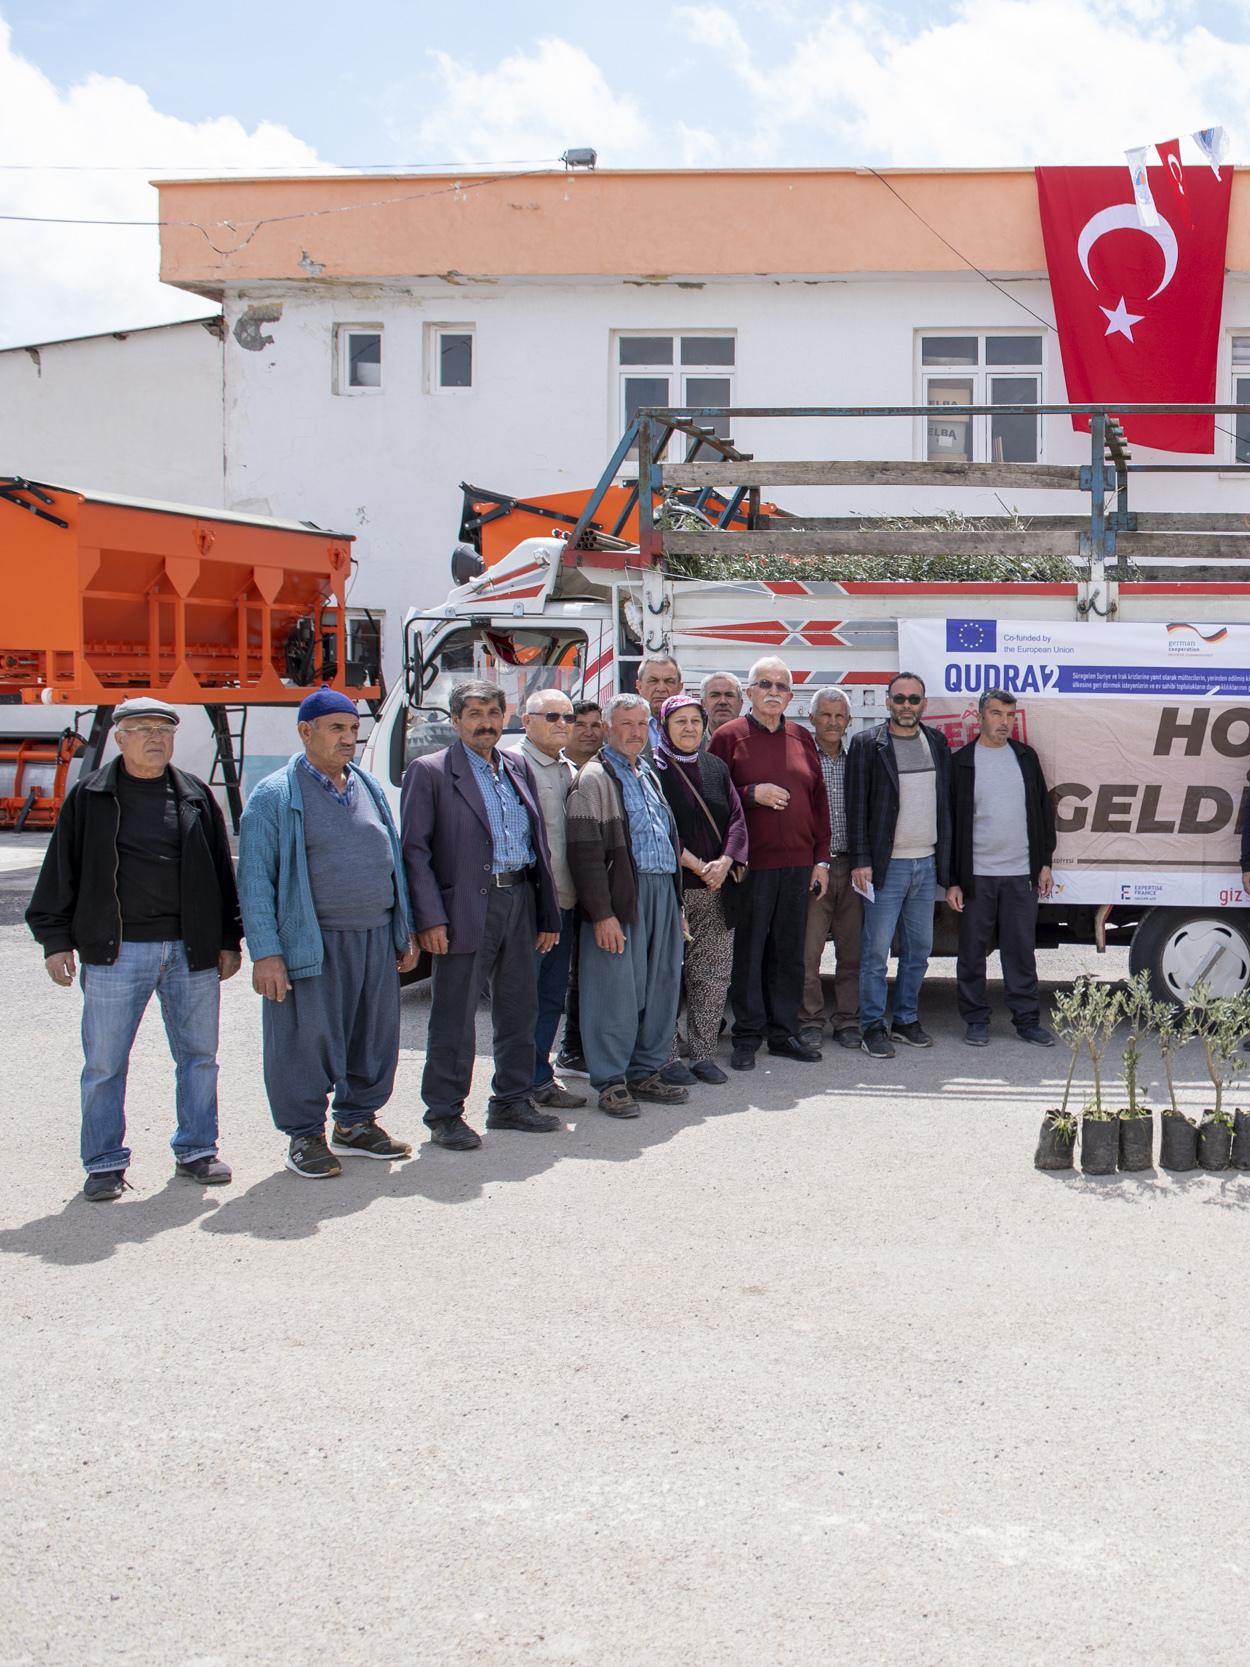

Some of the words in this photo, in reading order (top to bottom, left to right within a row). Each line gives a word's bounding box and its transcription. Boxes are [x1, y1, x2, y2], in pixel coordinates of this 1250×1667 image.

[928, 427, 957, 441] ELBA
[1003, 634, 1041, 642] Co-funded
[1042, 634, 1052, 643] by
[1017, 646, 1052, 654] European
[1219, 887, 1243, 906] giz
